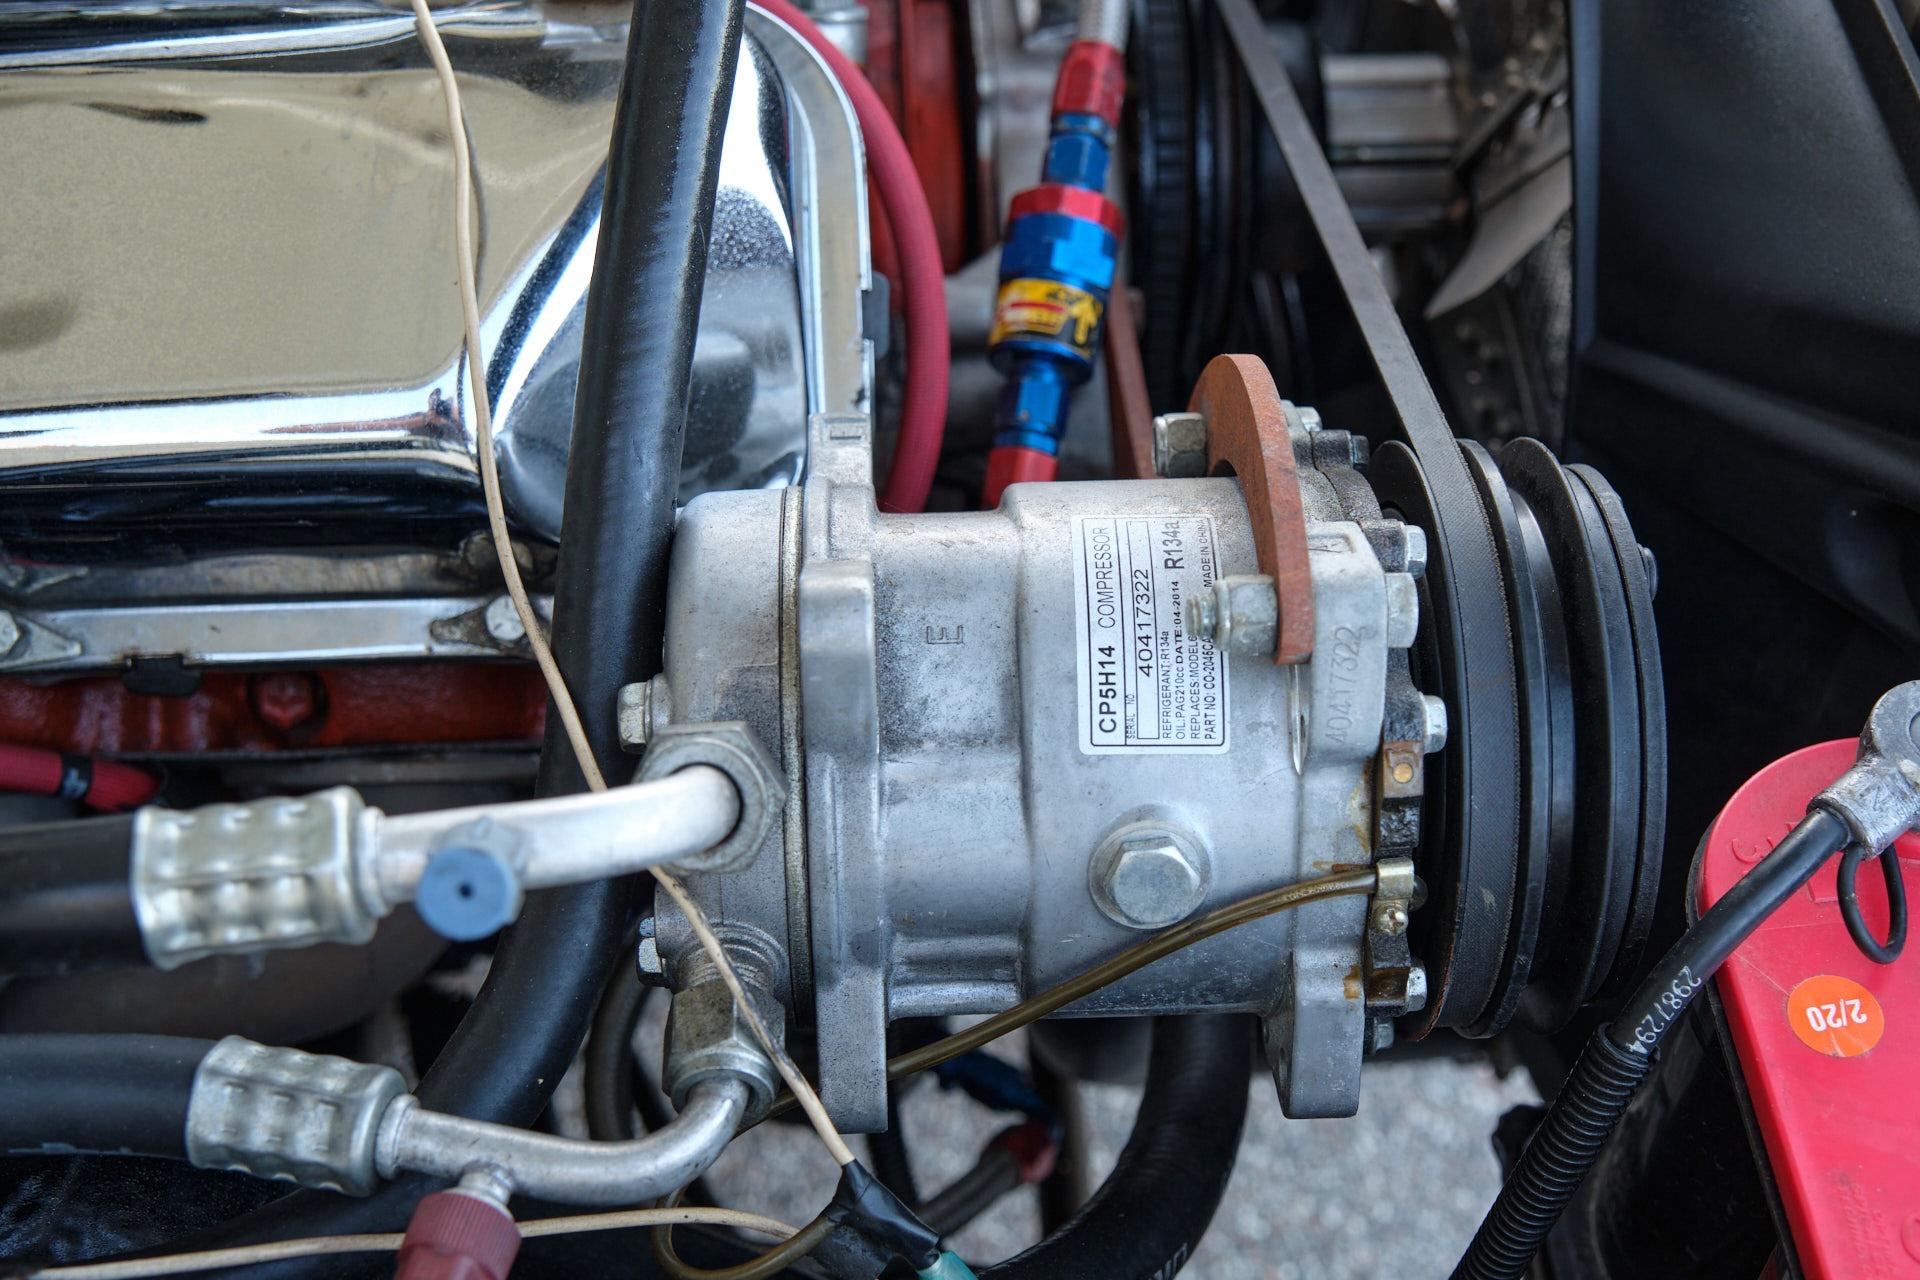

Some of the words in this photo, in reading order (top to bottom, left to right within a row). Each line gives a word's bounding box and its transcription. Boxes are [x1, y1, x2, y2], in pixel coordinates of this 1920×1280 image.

[1161, 520, 1185, 569] R134a
[1196, 519, 1208, 544] CHINA
[1200, 546, 1209, 556] IN
[1092, 527, 1116, 629] COMPRESSOR
[1201, 558, 1213, 588] MADE
[1133, 569, 1153, 677] 40417322
[1098, 645, 1117, 733] CP5H14
[1161, 631, 1172, 739] REFRIGERANT:R134a
[1204, 692, 1216, 711] NO:
[1174, 667, 1186, 740] OIL:PAG210cc
[1126, 713, 1136, 739] SERIAL
[1204, 713, 1216, 740] PART
[1806, 998, 1868, 1032] 2/20
